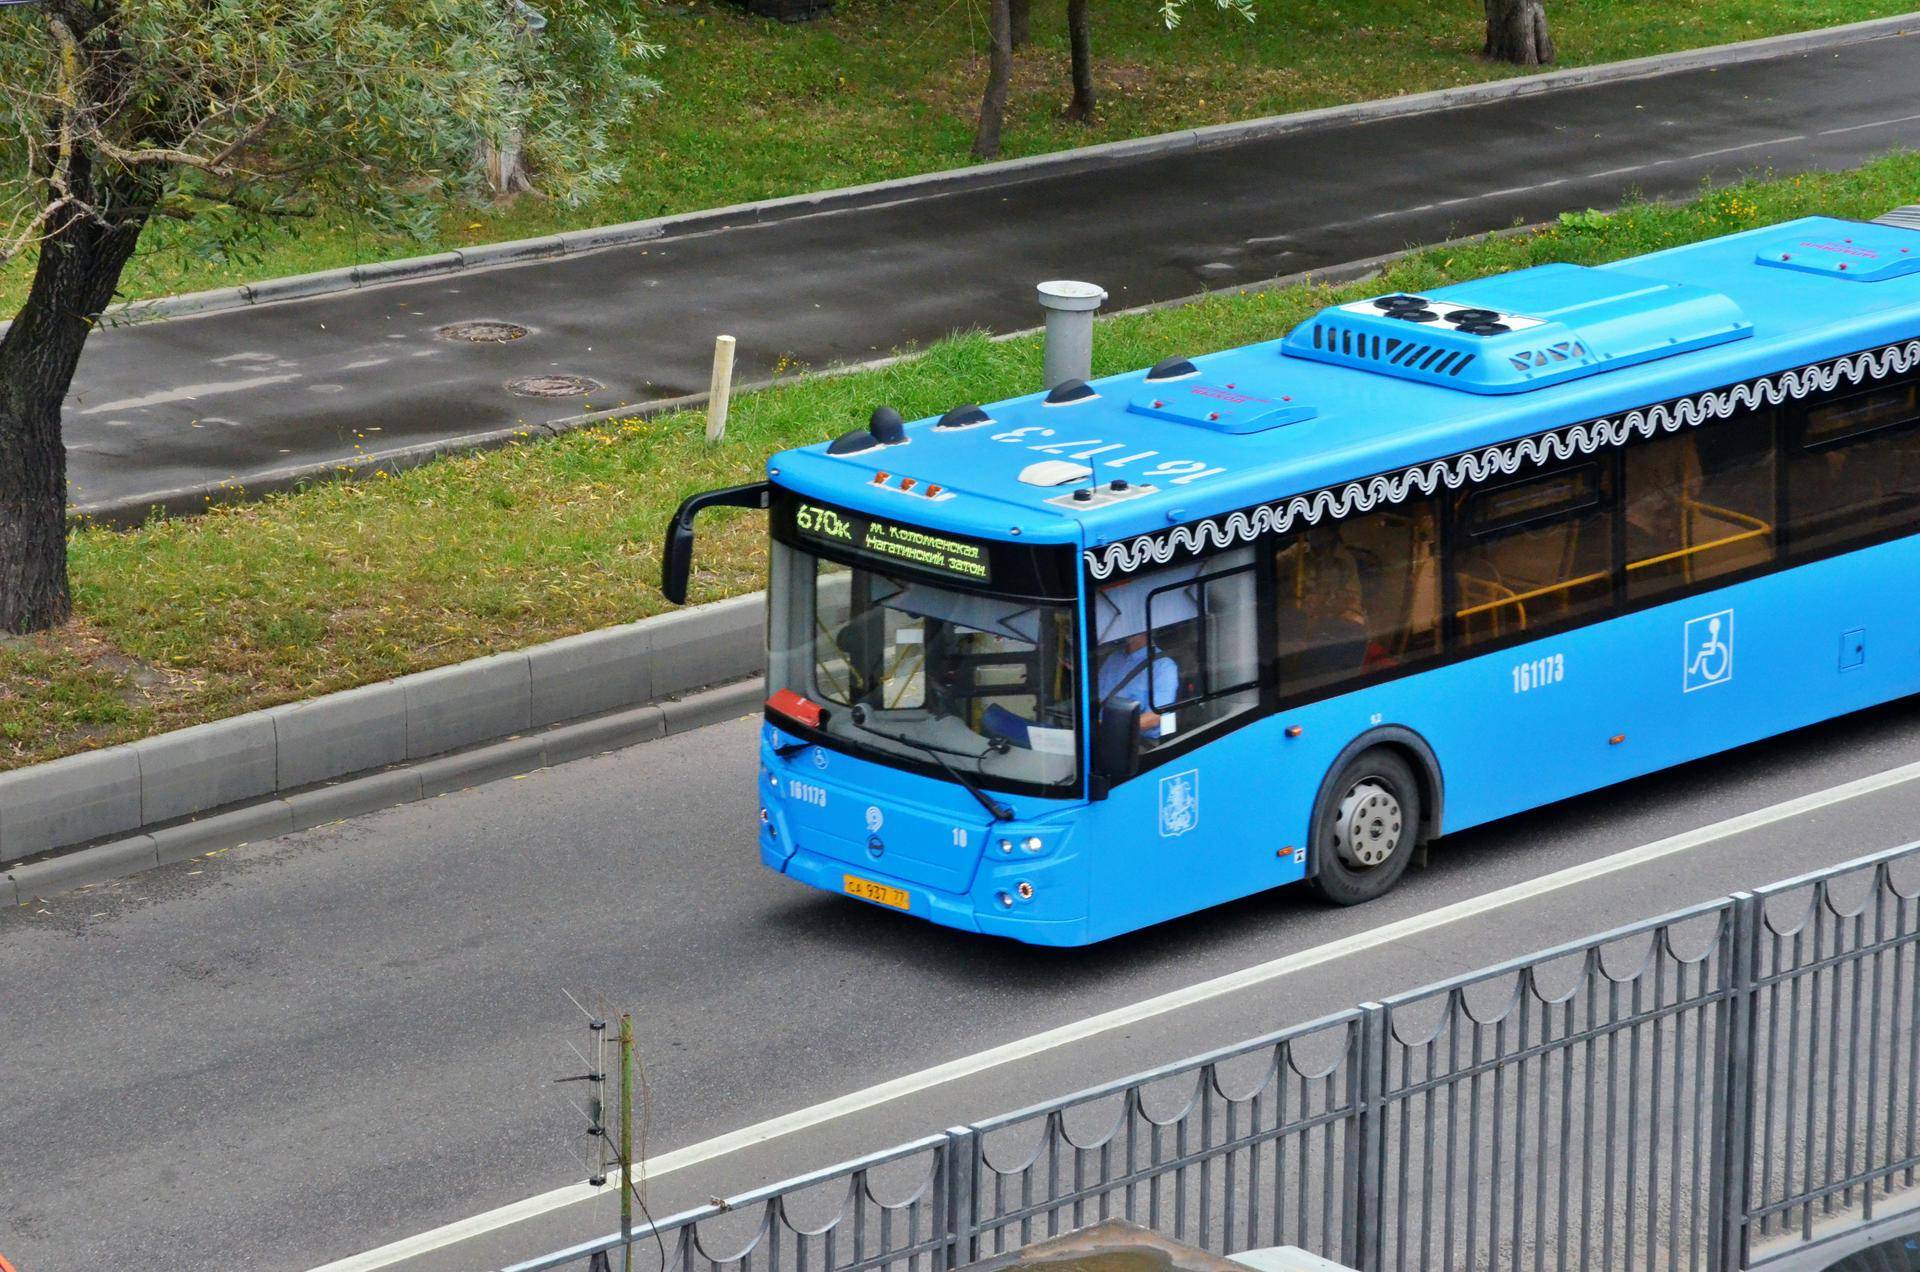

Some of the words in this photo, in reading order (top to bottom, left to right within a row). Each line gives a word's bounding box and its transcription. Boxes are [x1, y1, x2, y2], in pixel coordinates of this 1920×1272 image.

[865, 534, 945, 566] Нагатинский
[948, 558, 987, 577] затон
[890, 526, 979, 558] Коломенская
[1512, 653, 1564, 693] 161173
[789, 779, 827, 807] 161173
